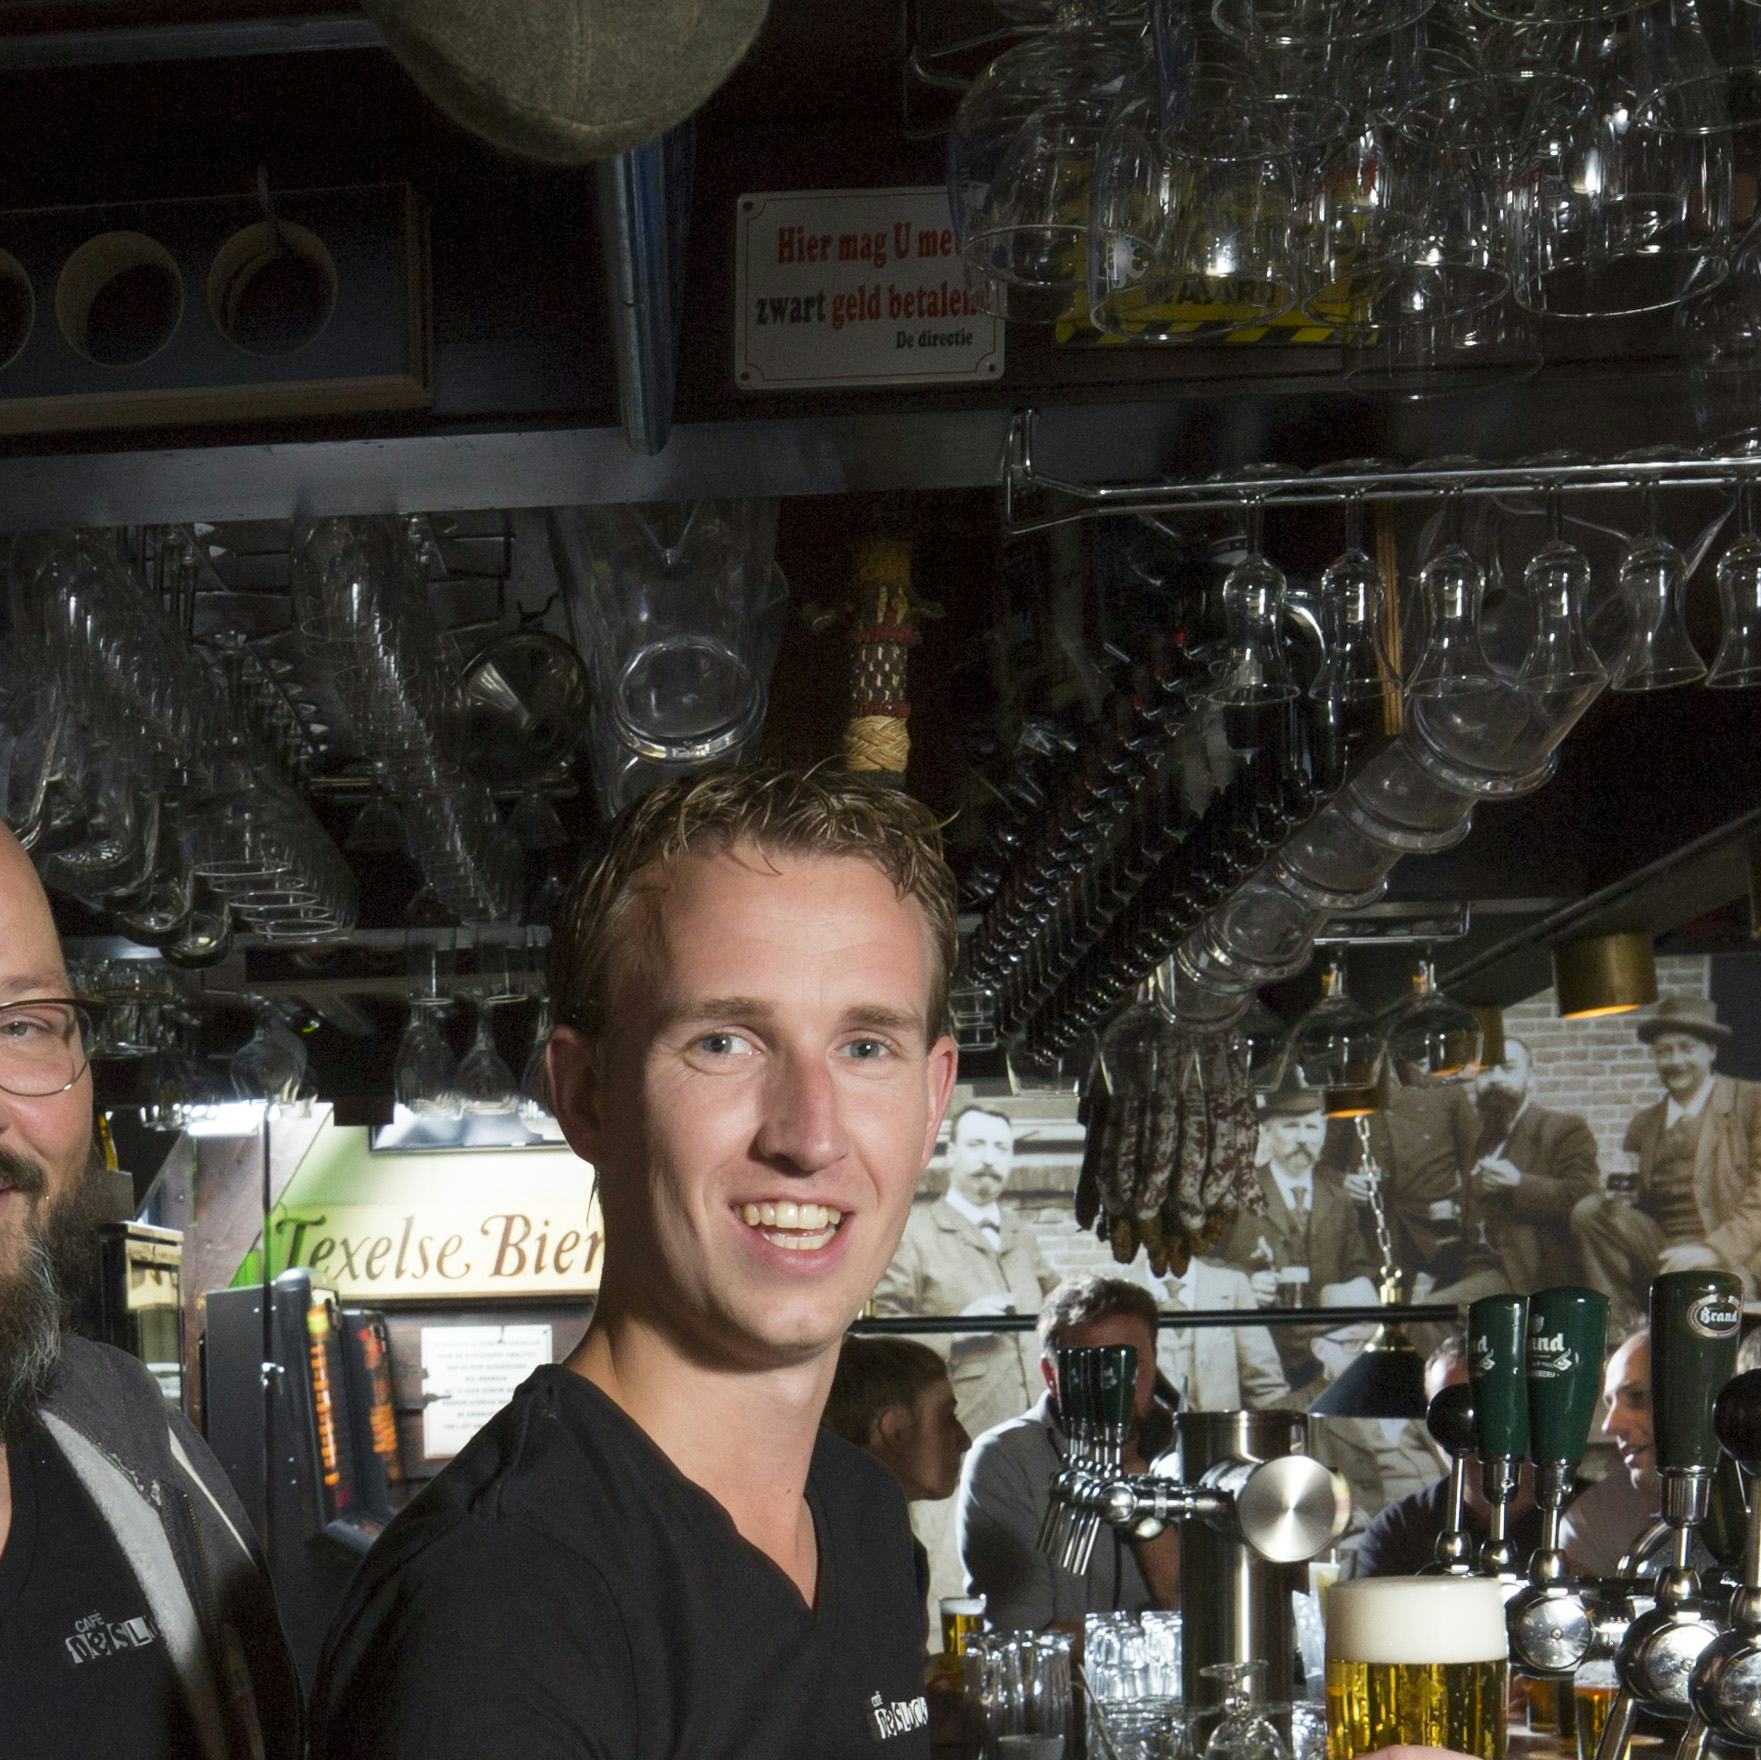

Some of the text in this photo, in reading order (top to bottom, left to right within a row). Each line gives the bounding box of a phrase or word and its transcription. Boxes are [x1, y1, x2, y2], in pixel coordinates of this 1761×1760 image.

[777, 225, 833, 264] Hier
[838, 231, 888, 269] mag
[894, 222, 912, 260] U
[755, 290, 827, 326] zwart
[831, 284, 882, 331] geld
[896, 328, 974, 349] De directie
[275, 1214, 471, 1281] Texelse
[1700, 1305, 1738, 1324] Brand
